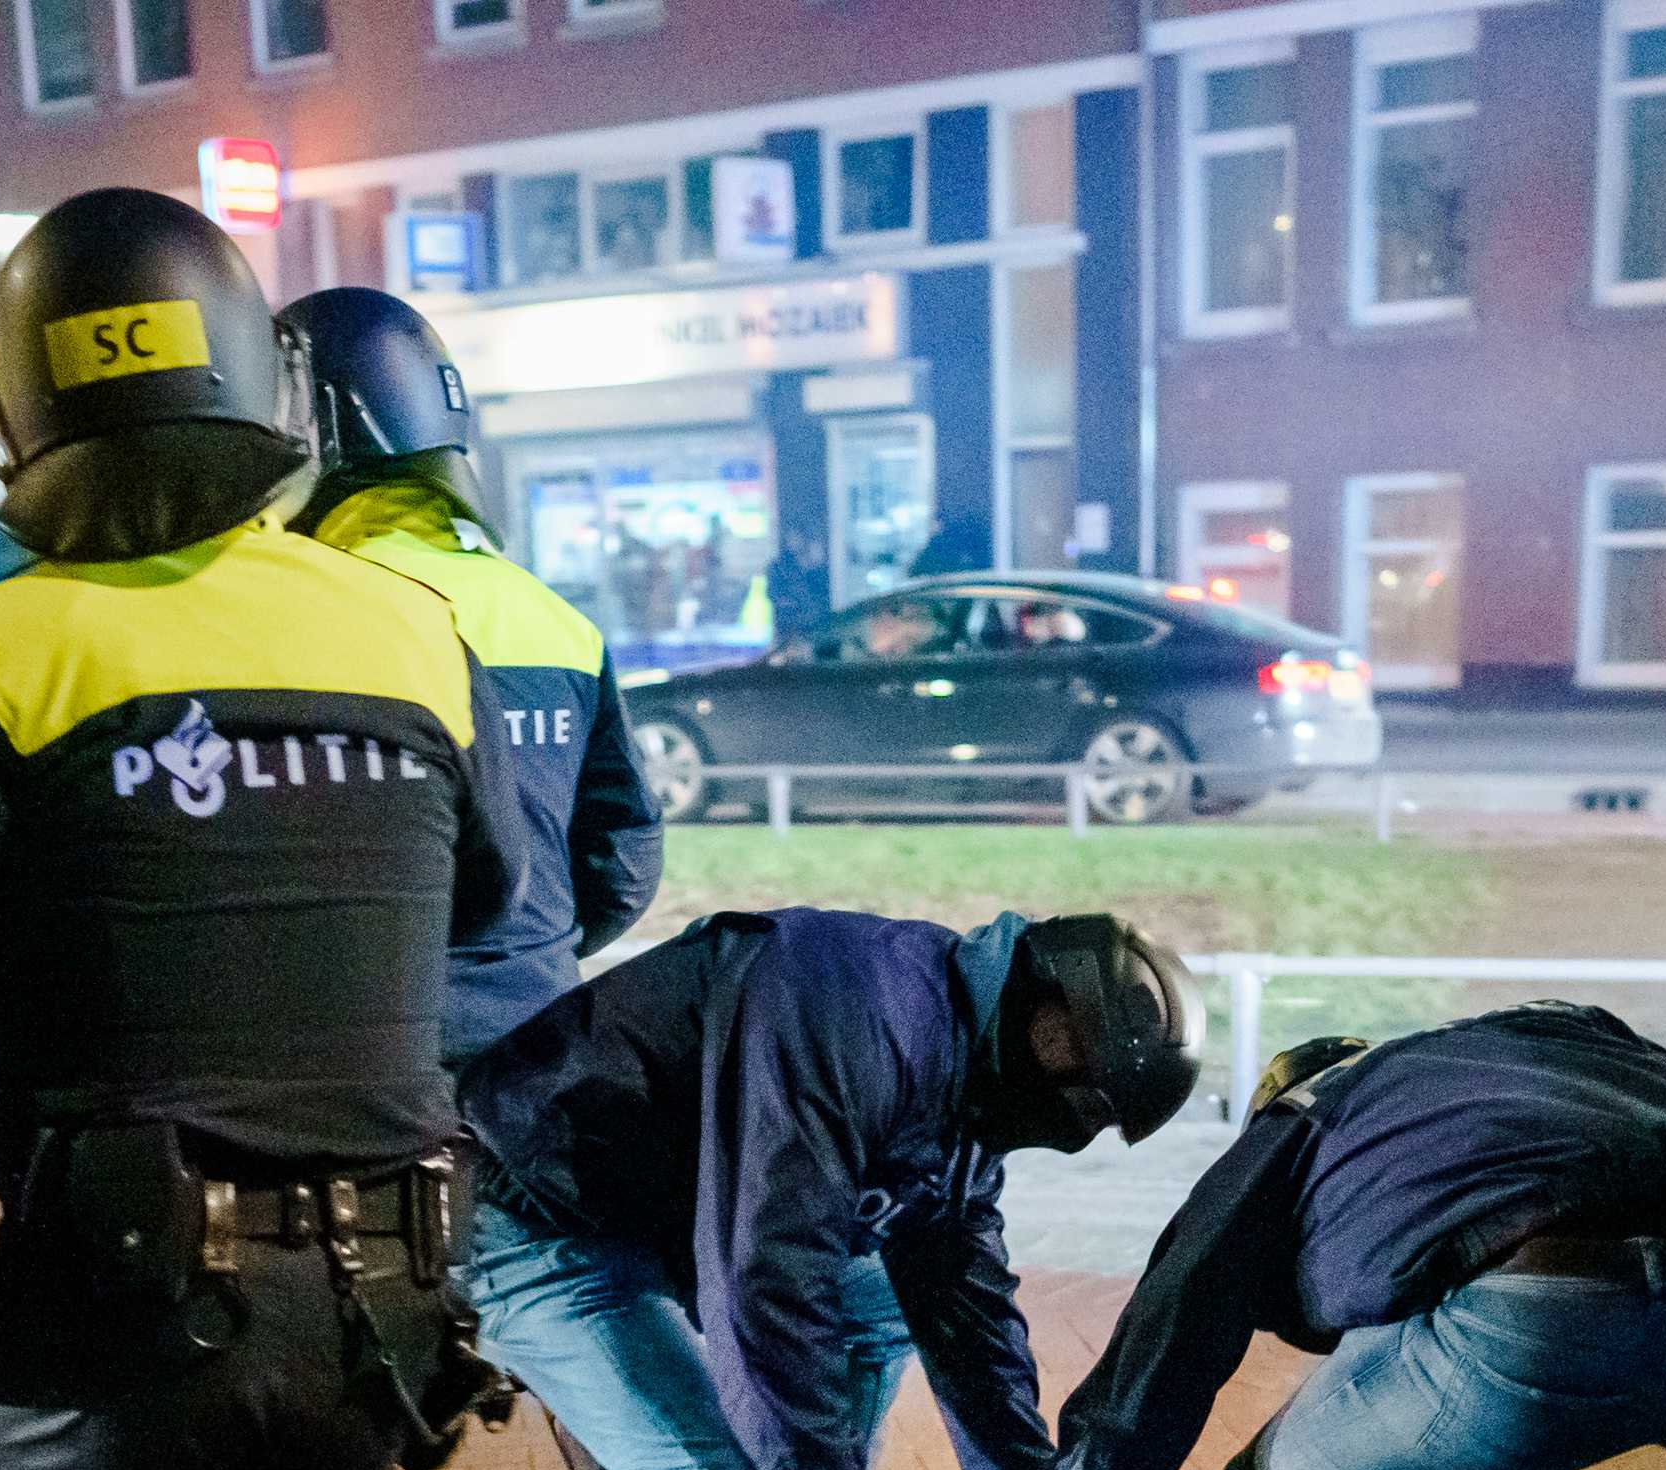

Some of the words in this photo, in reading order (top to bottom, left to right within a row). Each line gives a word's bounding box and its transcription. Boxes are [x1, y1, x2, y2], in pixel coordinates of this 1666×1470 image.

[94, 318, 155, 365] SC
[503, 709, 571, 745] TIE
[113, 714, 428, 817] POLITIE
